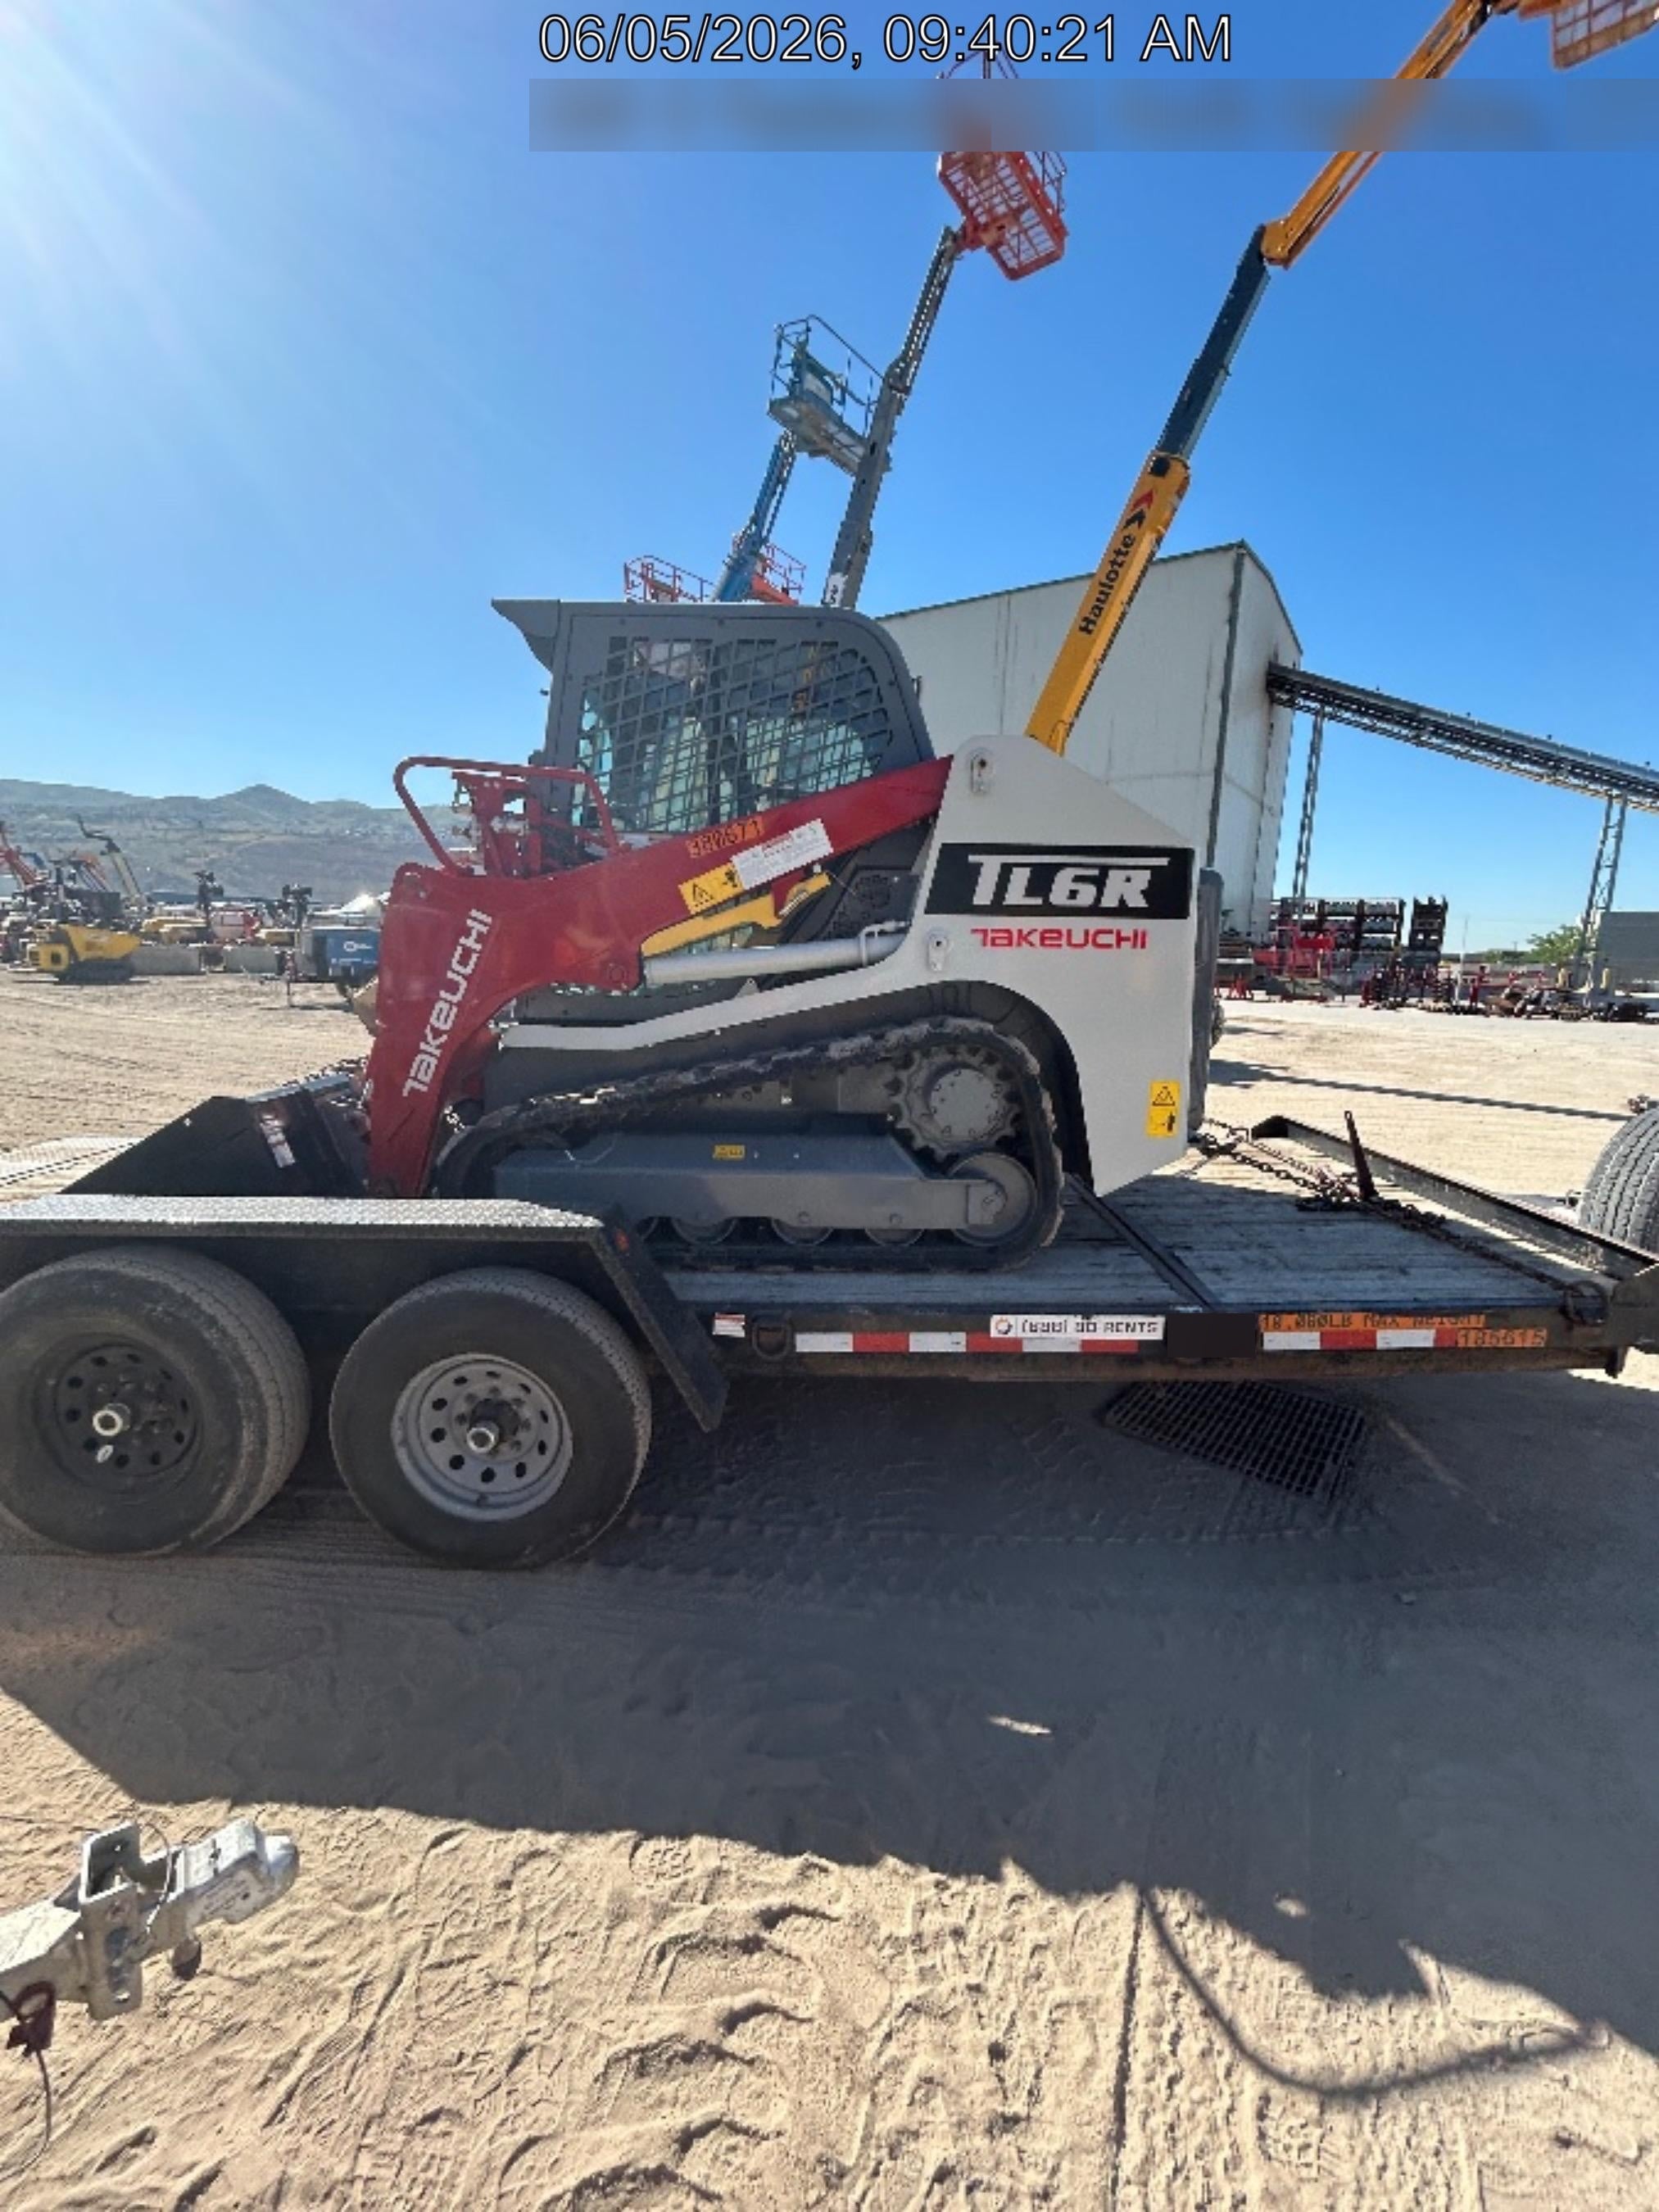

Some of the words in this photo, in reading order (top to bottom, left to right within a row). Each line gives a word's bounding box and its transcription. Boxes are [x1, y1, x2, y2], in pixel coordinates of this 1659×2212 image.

[1079, 534, 1136, 635] Haulotte
[968, 854, 1170, 908] TL6R
[1103, 1321, 1158, 1334] RENTS
